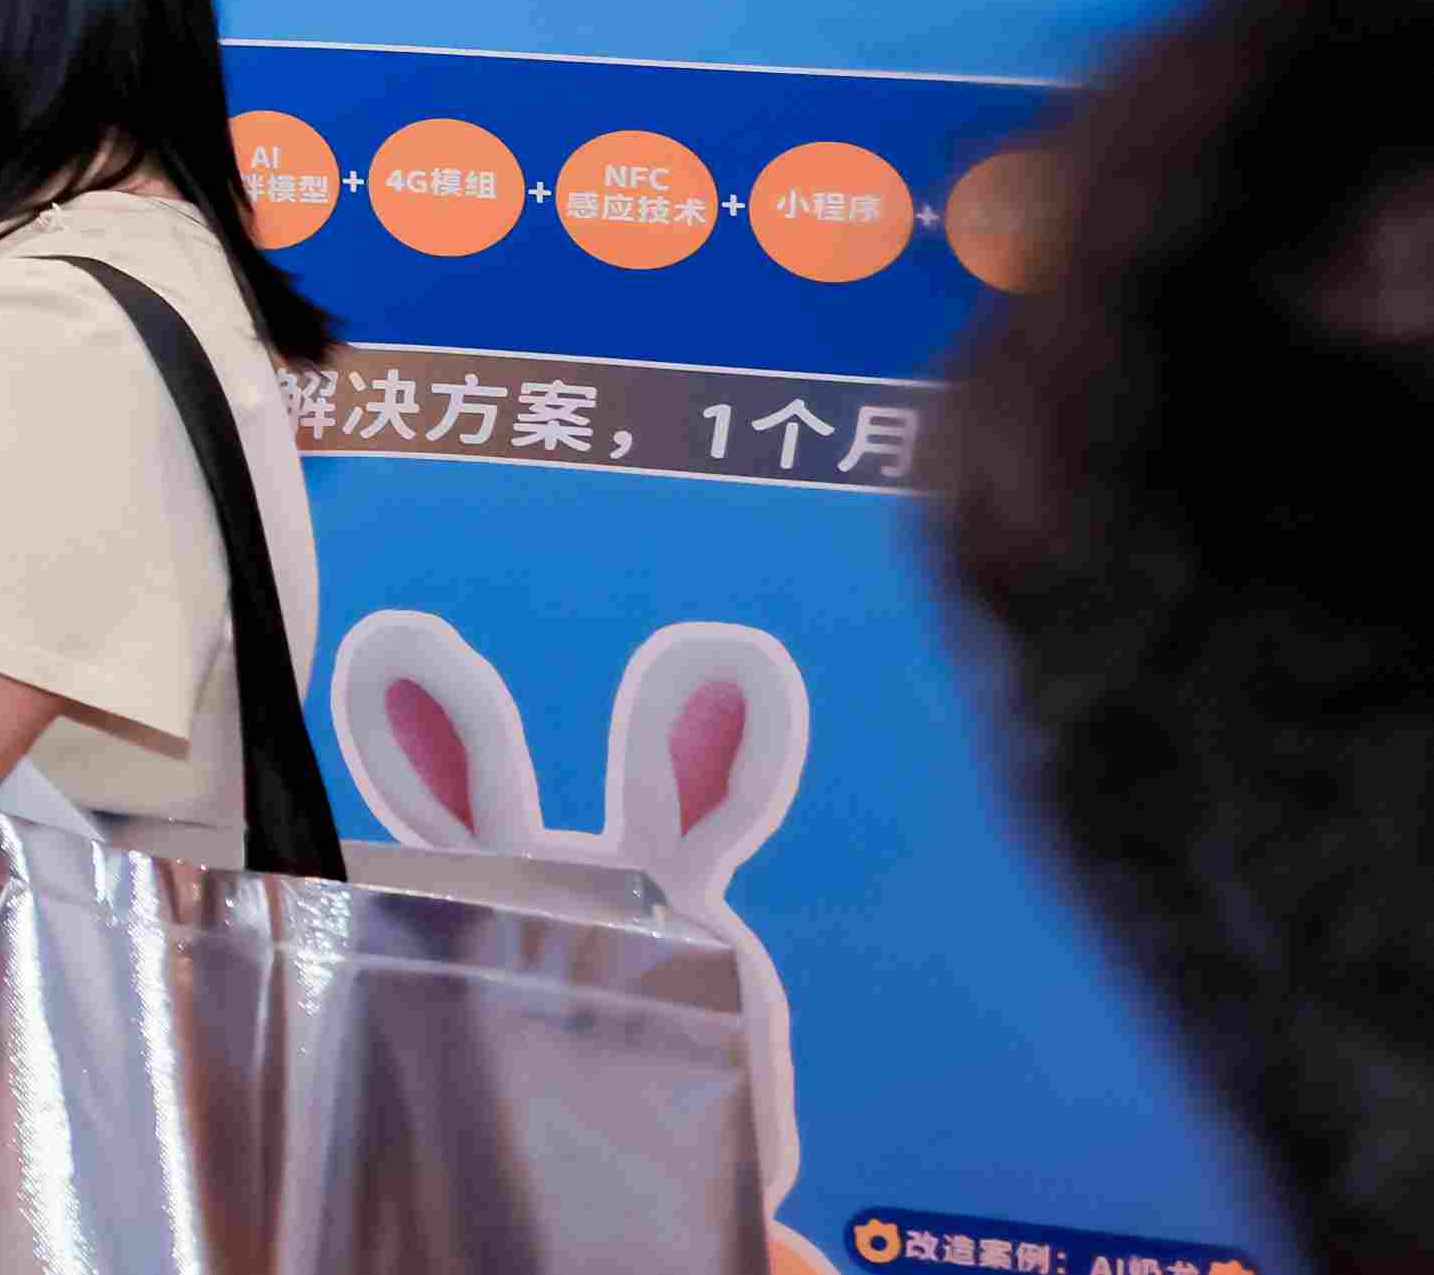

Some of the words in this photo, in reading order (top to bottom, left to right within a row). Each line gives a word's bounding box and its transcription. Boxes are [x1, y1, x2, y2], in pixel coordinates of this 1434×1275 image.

[251, 146, 281, 169] AI
[385, 168, 497, 199] 4G模组
[604, 164, 670, 192] NFC
[566, 191, 707, 227] 感应技术
[776, 191, 882, 223] 小程序
